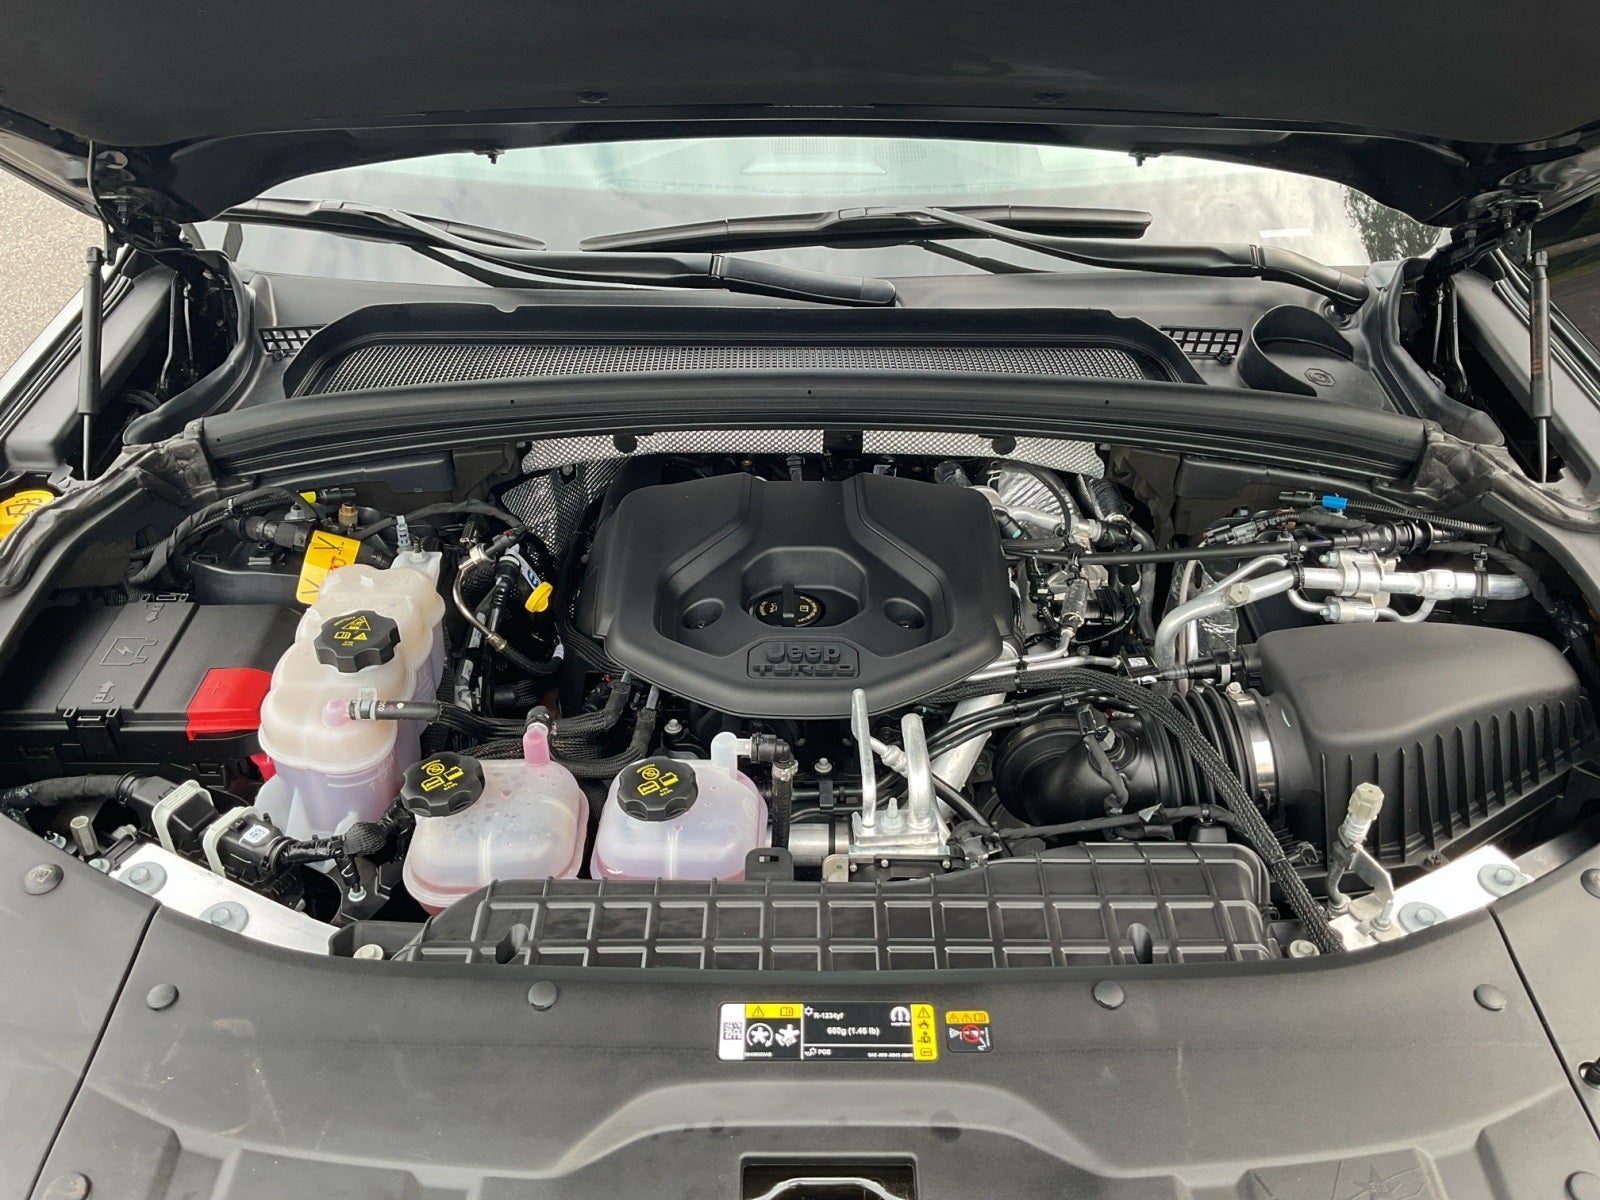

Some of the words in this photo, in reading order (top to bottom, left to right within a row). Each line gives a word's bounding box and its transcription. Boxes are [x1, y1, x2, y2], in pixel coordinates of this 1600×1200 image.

[766, 642, 841, 664] Jeep
[753, 664, 855, 677] TURBO
[813, 1012, 844, 1020] R-1234yf
